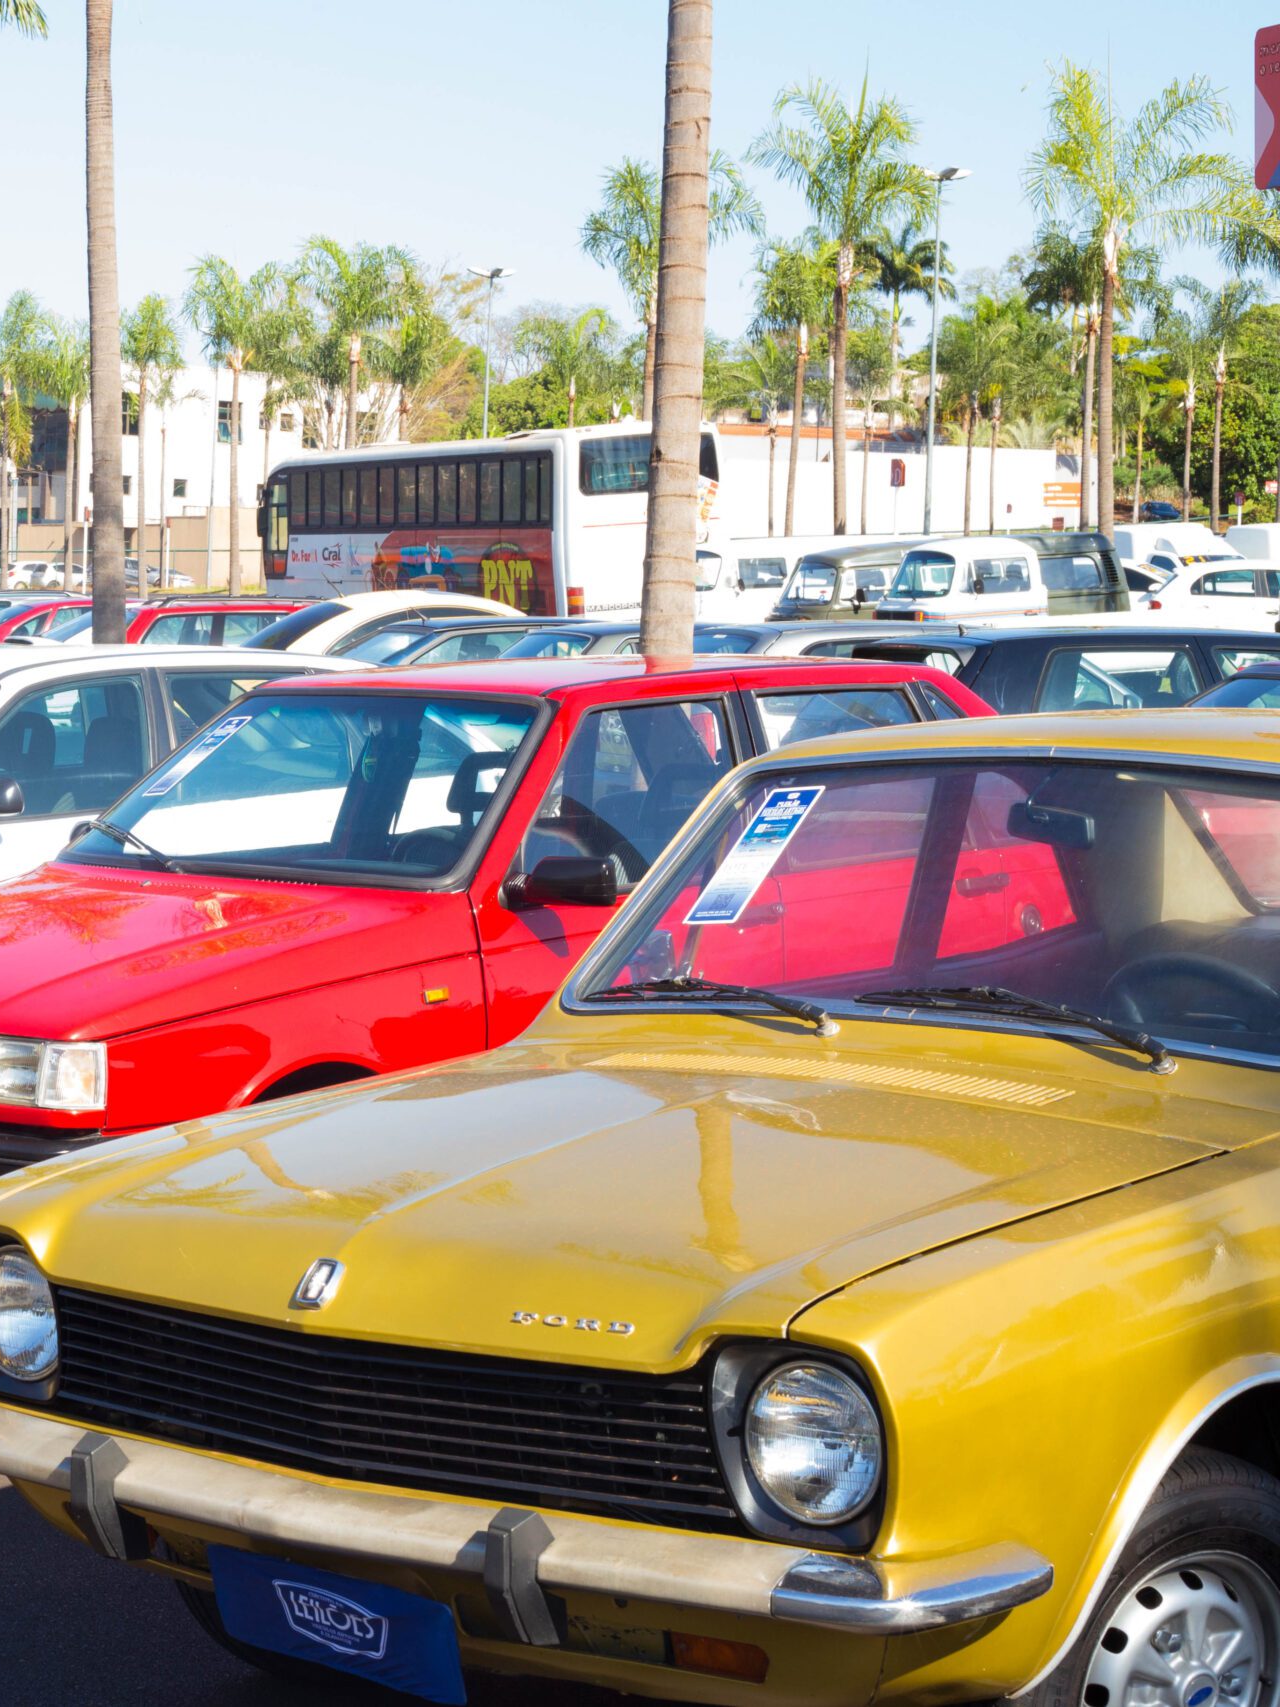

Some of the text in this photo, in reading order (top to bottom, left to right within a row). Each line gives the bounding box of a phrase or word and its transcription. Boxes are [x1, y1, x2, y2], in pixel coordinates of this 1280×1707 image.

[481, 559, 533, 611] PNT
[510, 1311, 636, 1336] FORD
[289, 1590, 375, 1639] LEILÕES
